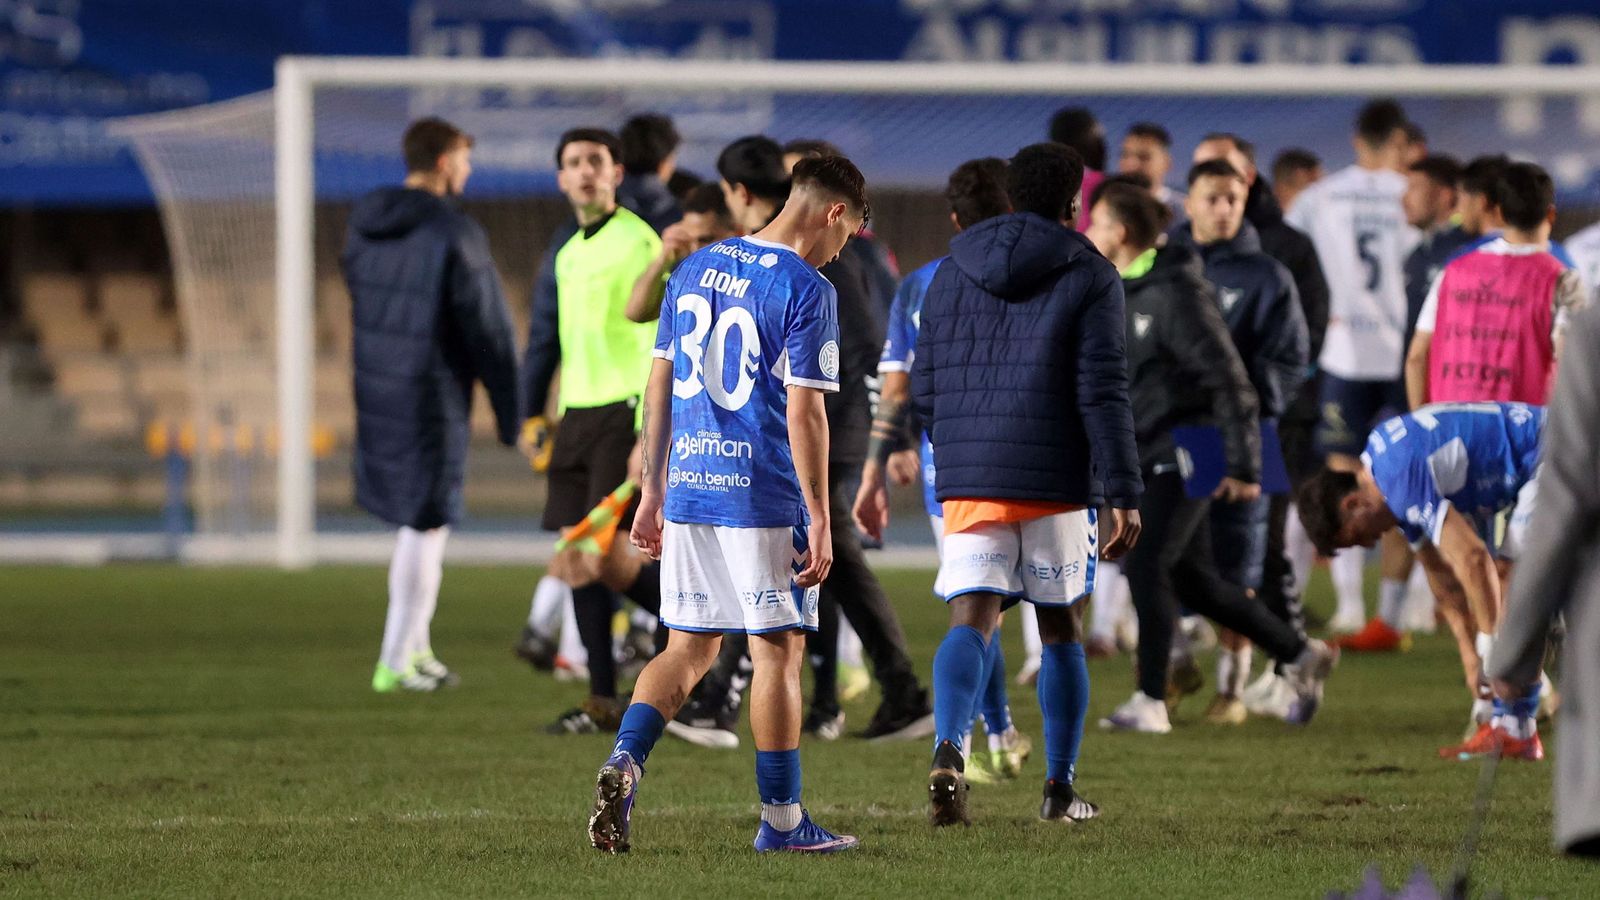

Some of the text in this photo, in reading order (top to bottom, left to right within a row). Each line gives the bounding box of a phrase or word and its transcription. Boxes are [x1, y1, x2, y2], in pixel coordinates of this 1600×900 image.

[710, 242, 757, 265] indeso
[1357, 229, 1382, 294] 5
[699, 268, 752, 298] DOMI
[672, 293, 761, 412] 30
[681, 470, 751, 487] san benito
